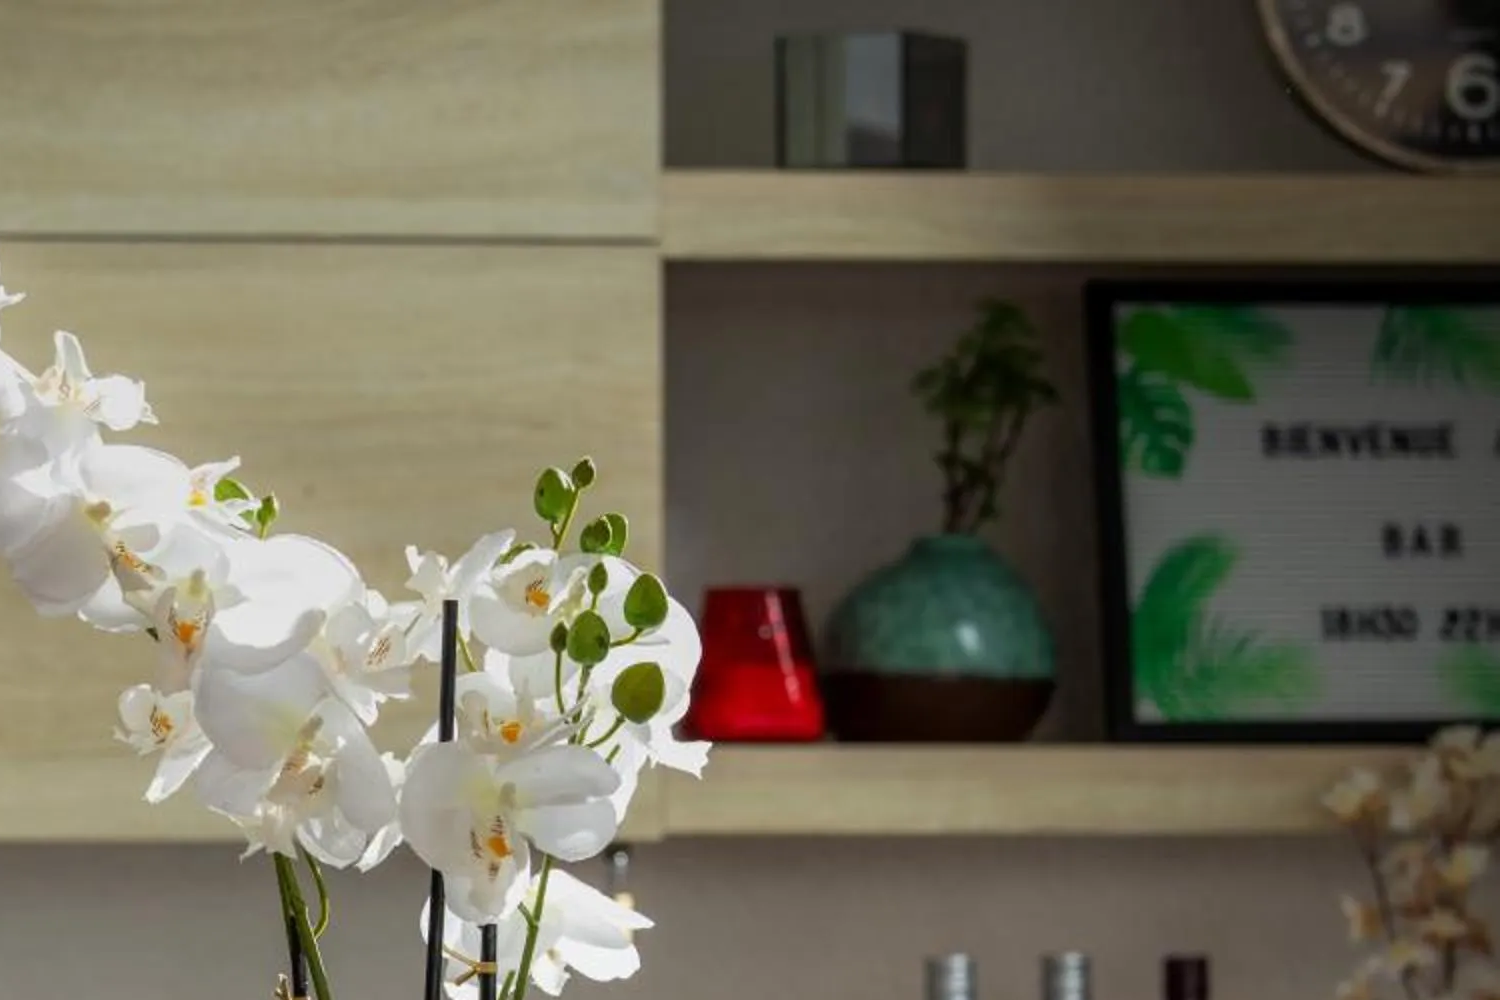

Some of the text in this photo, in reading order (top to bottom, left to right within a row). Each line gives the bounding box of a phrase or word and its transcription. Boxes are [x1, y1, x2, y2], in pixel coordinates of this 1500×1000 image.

[1327, 3, 1367, 46] 8
[1374, 61, 1412, 118] 7
[1446, 54, 1499, 118] 6
[1261, 422, 1456, 458] BIENVENUE
[1382, 523, 1463, 558] BAR
